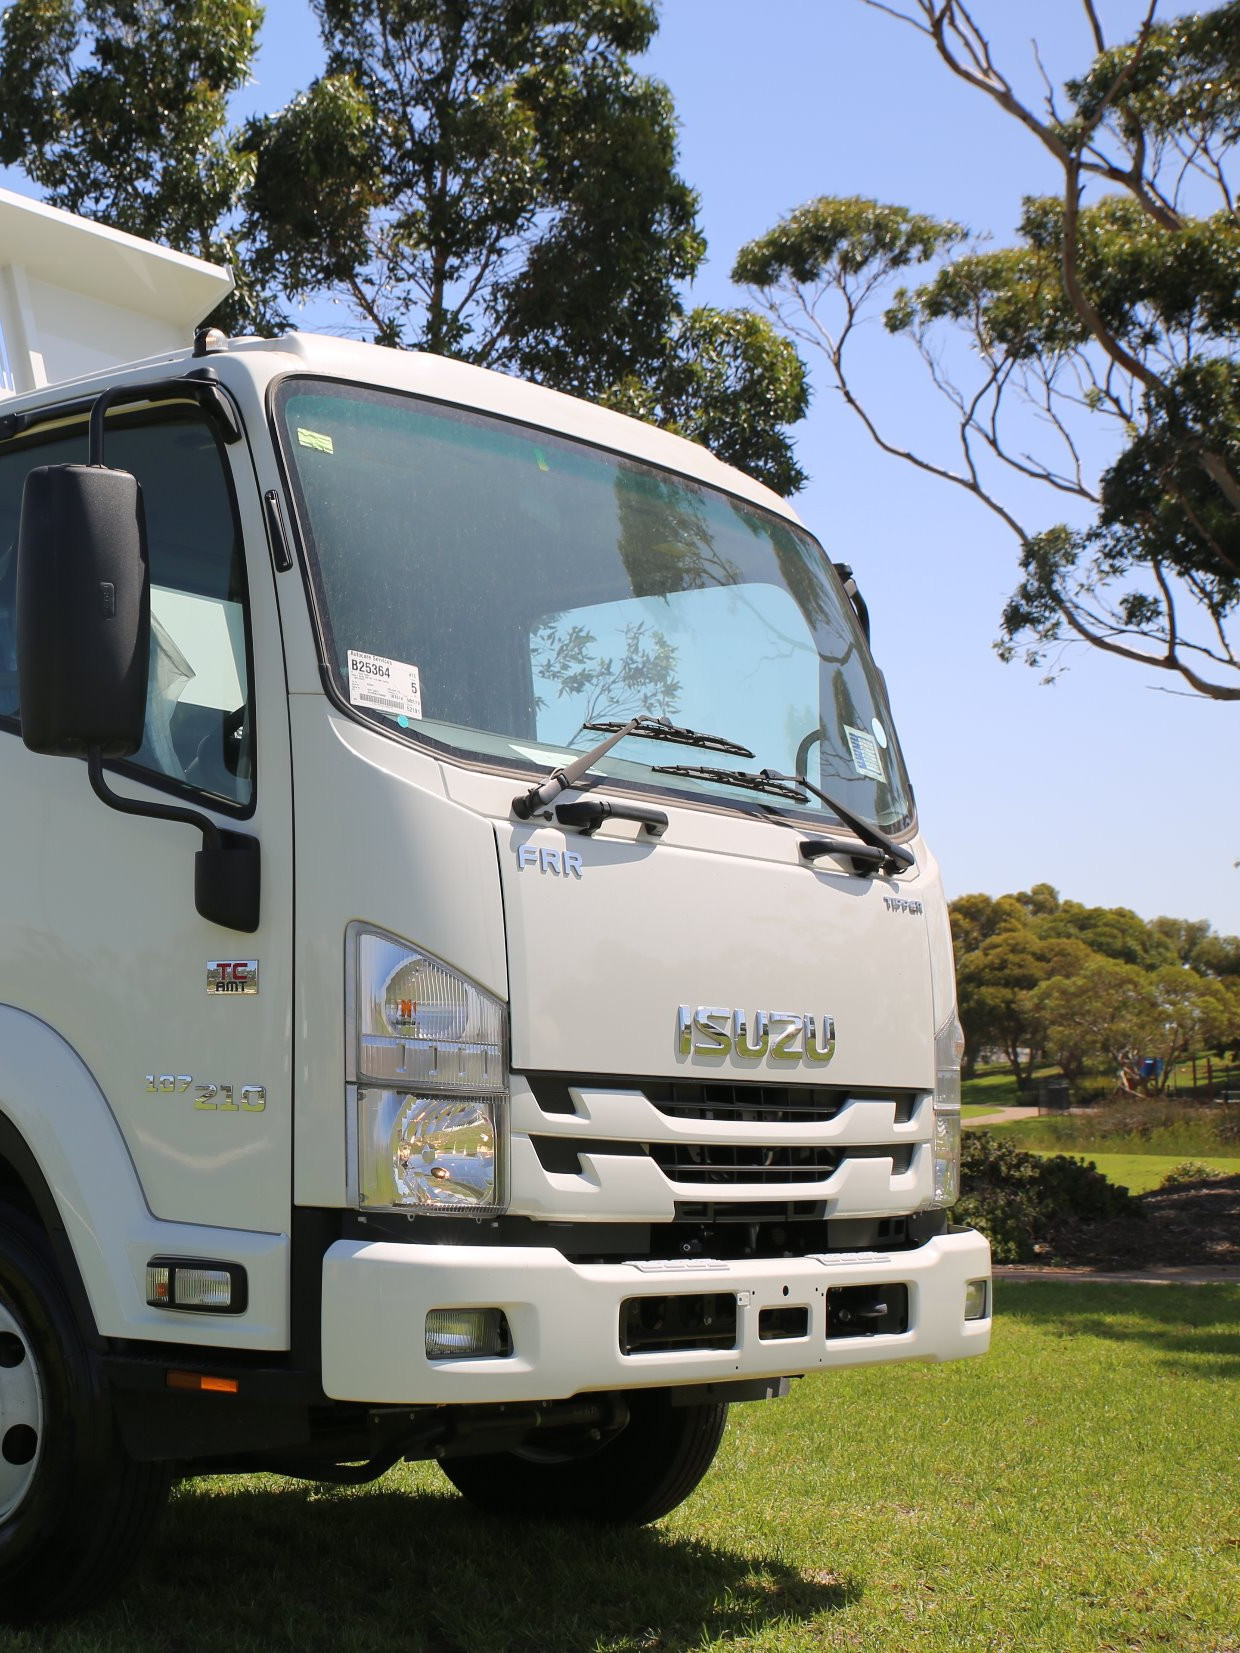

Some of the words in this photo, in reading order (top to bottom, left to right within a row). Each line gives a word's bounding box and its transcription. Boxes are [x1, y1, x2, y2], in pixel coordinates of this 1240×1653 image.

[351, 659, 391, 678] B25364
[411, 682, 418, 694] 5
[517, 844, 584, 880] FRR
[883, 896, 923, 915] TIPPER
[216, 963, 249, 981] TC
[215, 981, 248, 992] AMT
[677, 1004, 836, 1062] ISUZU
[145, 1074, 193, 1093] 107
[193, 1084, 267, 1113] 210
